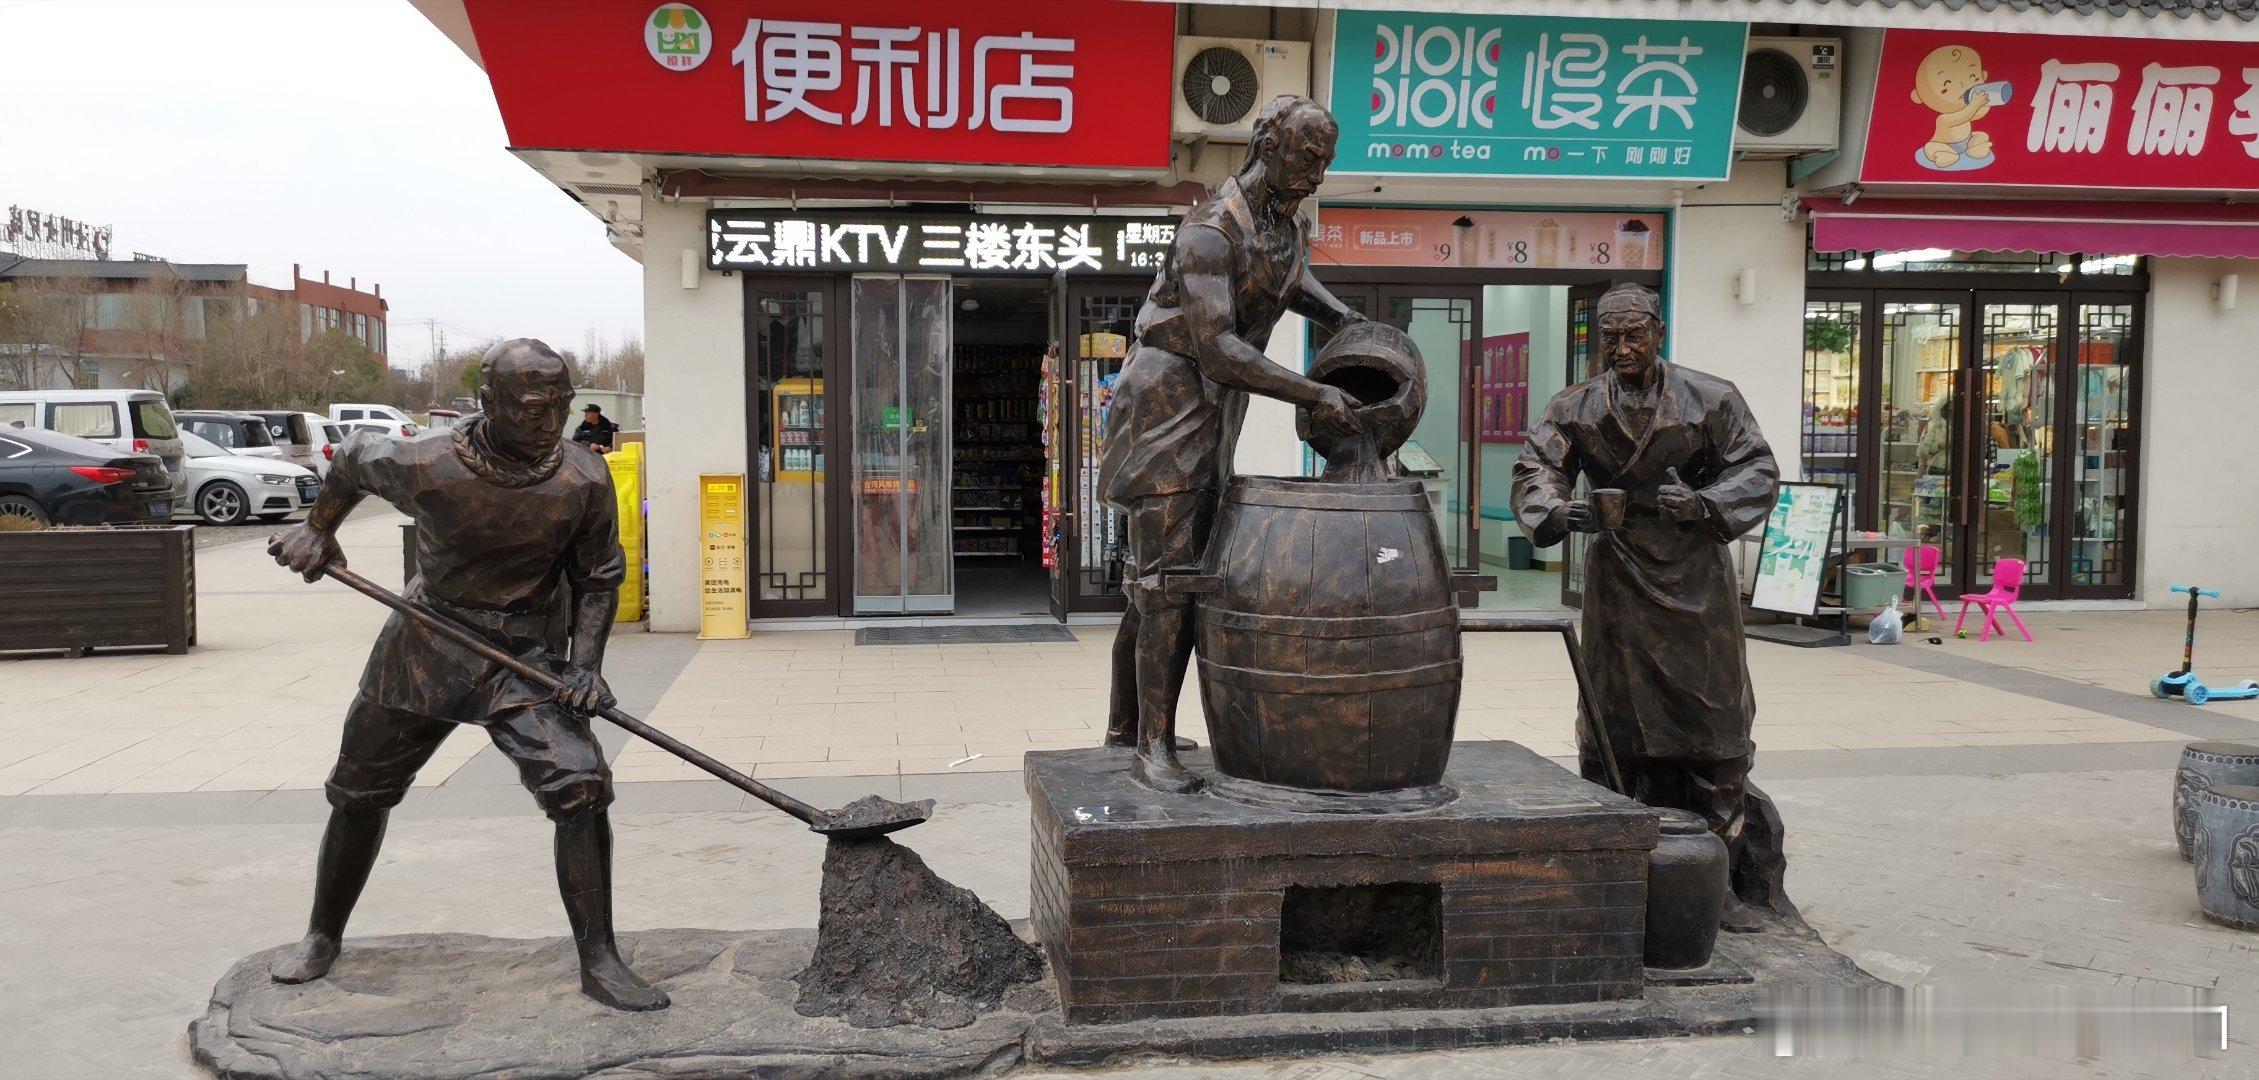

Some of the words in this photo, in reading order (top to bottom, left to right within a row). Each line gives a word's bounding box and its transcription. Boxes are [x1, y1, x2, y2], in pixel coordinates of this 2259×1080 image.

[732, 18, 1076, 133] 便利店
[1522, 31, 1705, 132] 慢茶
[1368, 141, 1443, 161] momo
[1451, 141, 1491, 161] tea
[1626, 147, 1693, 166] 刚刚好
[1126, 223, 1175, 244] 星期五
[1359, 230, 1414, 247] 新品上市
[919, 221, 1103, 270] 三楼东头
